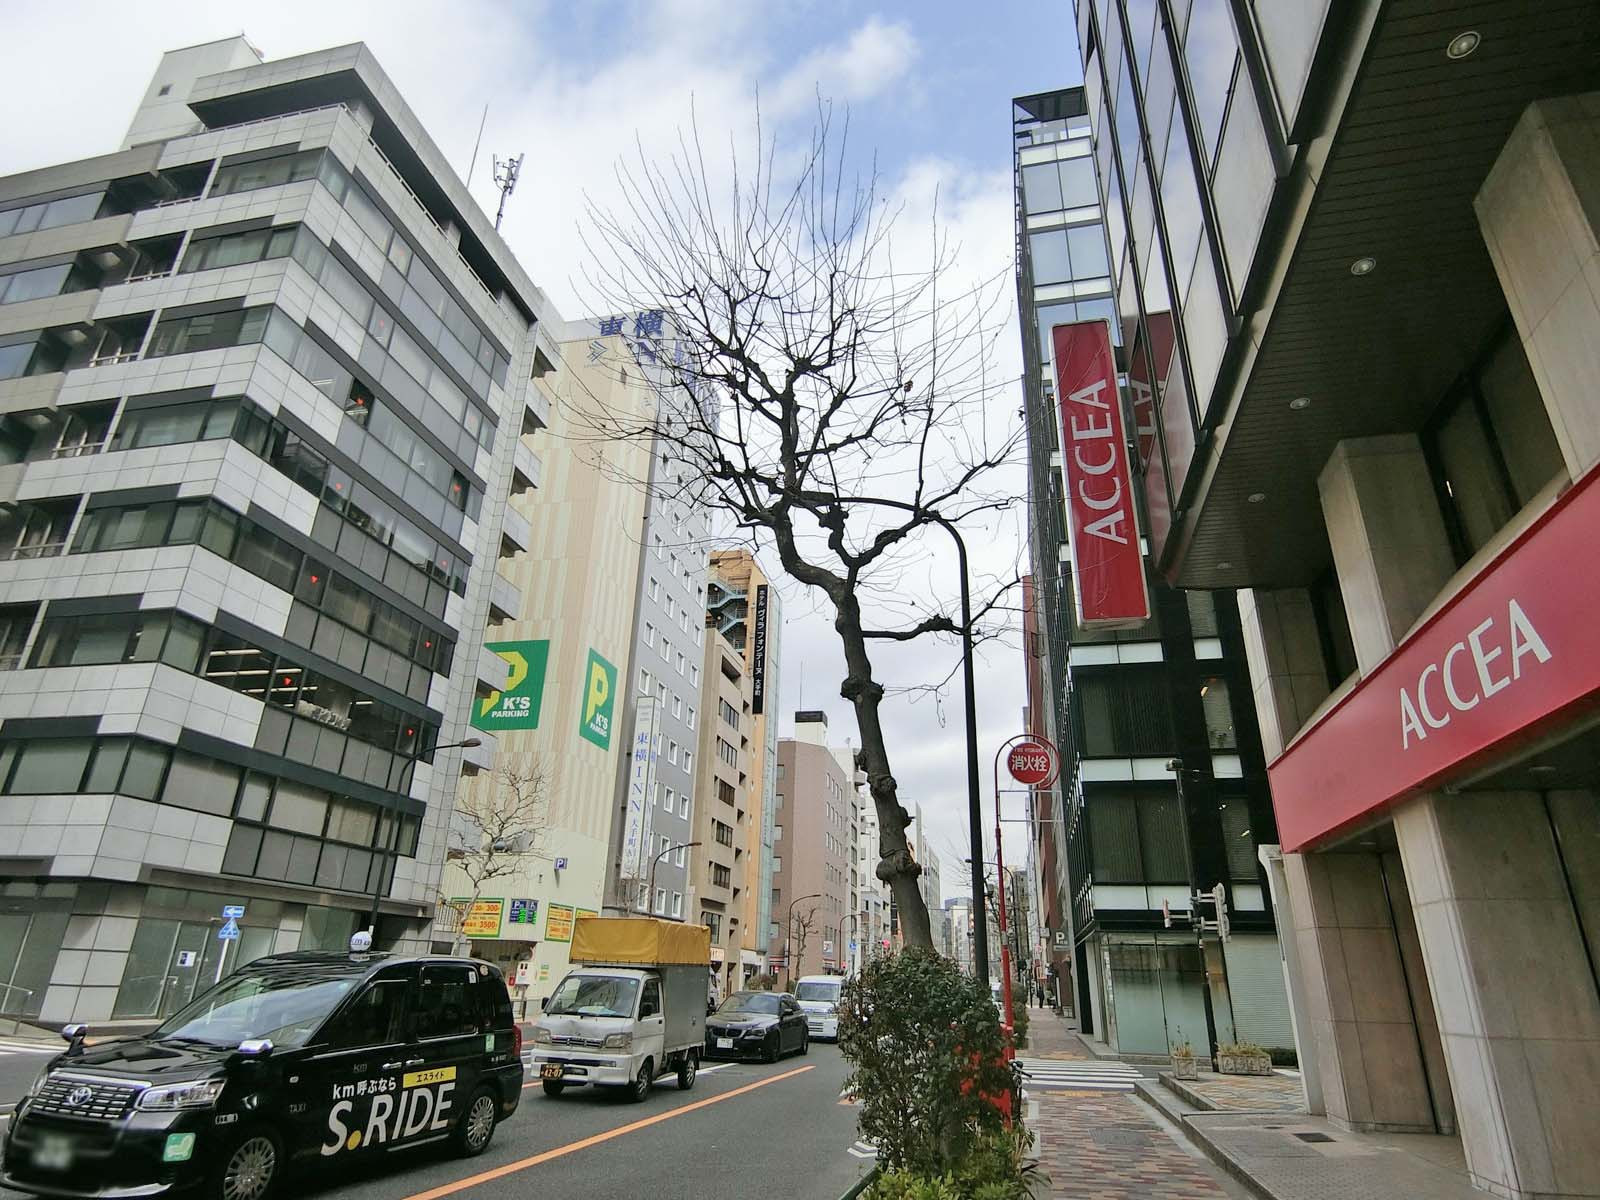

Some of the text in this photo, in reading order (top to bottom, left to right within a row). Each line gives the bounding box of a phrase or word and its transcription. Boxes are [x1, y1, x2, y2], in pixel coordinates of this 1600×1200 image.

[1069, 378, 1128, 545] ACCEA
[1400, 598, 1552, 750] ACCEA
[503, 696, 531, 710] K'S
[491, 709, 529, 718] PARKING
[1011, 755, 1048, 772] 消火栓
[556, 858, 564, 869] P
[1055, 931, 1065, 944] P
[320, 1082, 456, 1156] S.RIDE
